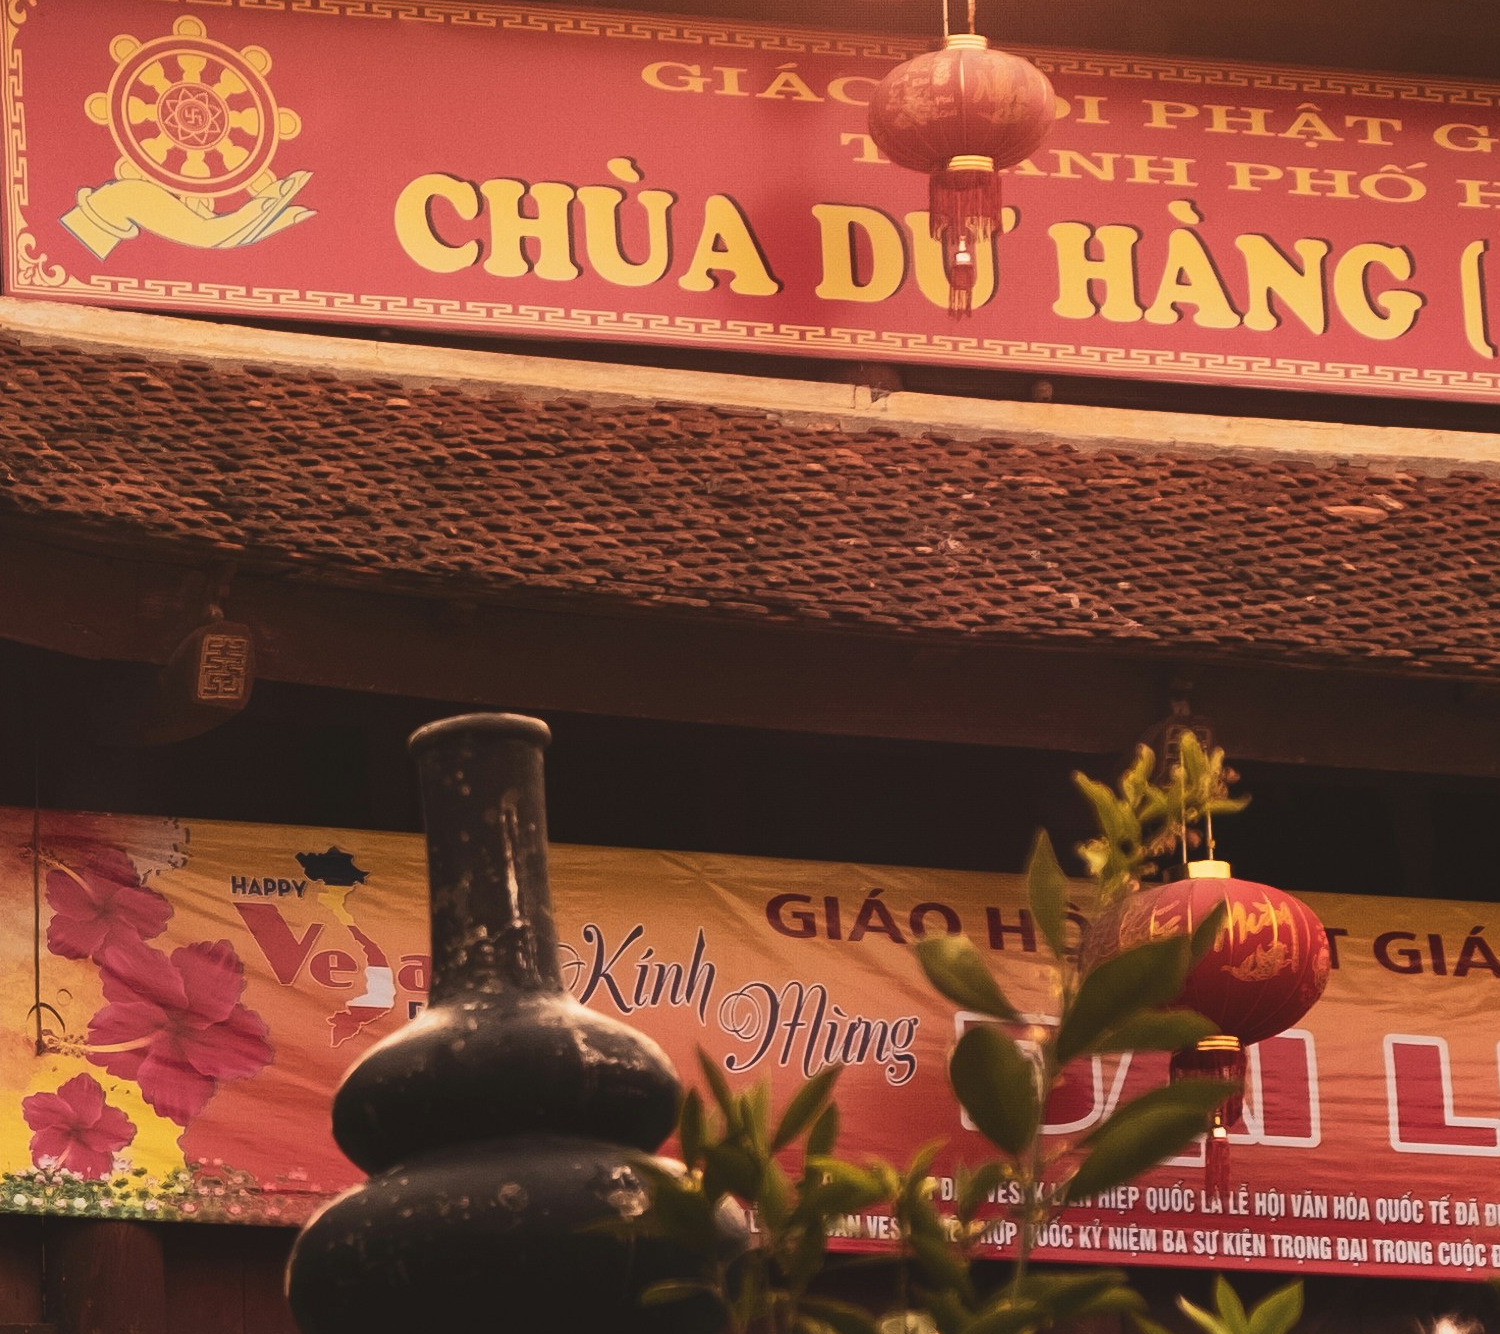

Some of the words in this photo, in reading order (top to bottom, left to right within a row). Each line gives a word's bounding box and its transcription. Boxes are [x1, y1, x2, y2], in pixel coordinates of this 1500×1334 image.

[641, 61, 882, 105] GIÁO
[1142, 99, 1402, 148] PHẬT
[840, 132, 1198, 187] TNH
[1226, 161, 1428, 203] PHỐ
[394, 157, 779, 296] CHÙA
[812, 203, 1014, 309] DƯ
[1049, 199, 1422, 341] HÀNG
[230, 874, 308, 899] HAPPY
[766, 889, 962, 944] GIÁO
[558, 923, 717, 1025] Kính
[719, 981, 919, 1087] Mừng
[1145, 1179, 1195, 1214] QUỐC
[1228, 1183, 1249, 1216] LỄ
[1255, 1187, 1285, 1222] HỘI
[1291, 1189, 1328, 1219] VĂN
[1333, 1192, 1371, 1221] HÓA
[1375, 1191, 1424, 1224] QUỐC
[1429, 1194, 1451, 1225] TẾ
[1455, 1198, 1479, 1227] ĐÃ
[1079, 1218, 1102, 1249] KỶ
[1108, 1223, 1157, 1257] NIỆM
[1162, 1230, 1188, 1254] BA
[1193, 1229, 1219, 1260] SỰ
[1223, 1227, 1266, 1262] KIỆN
[1270, 1234, 1332, 1265] TRỌNG
[1336, 1236, 1368, 1267] ĐẠI
[1372, 1239, 1433, 1266] TRONG
[1438, 1238, 1486, 1272] CUỘC
